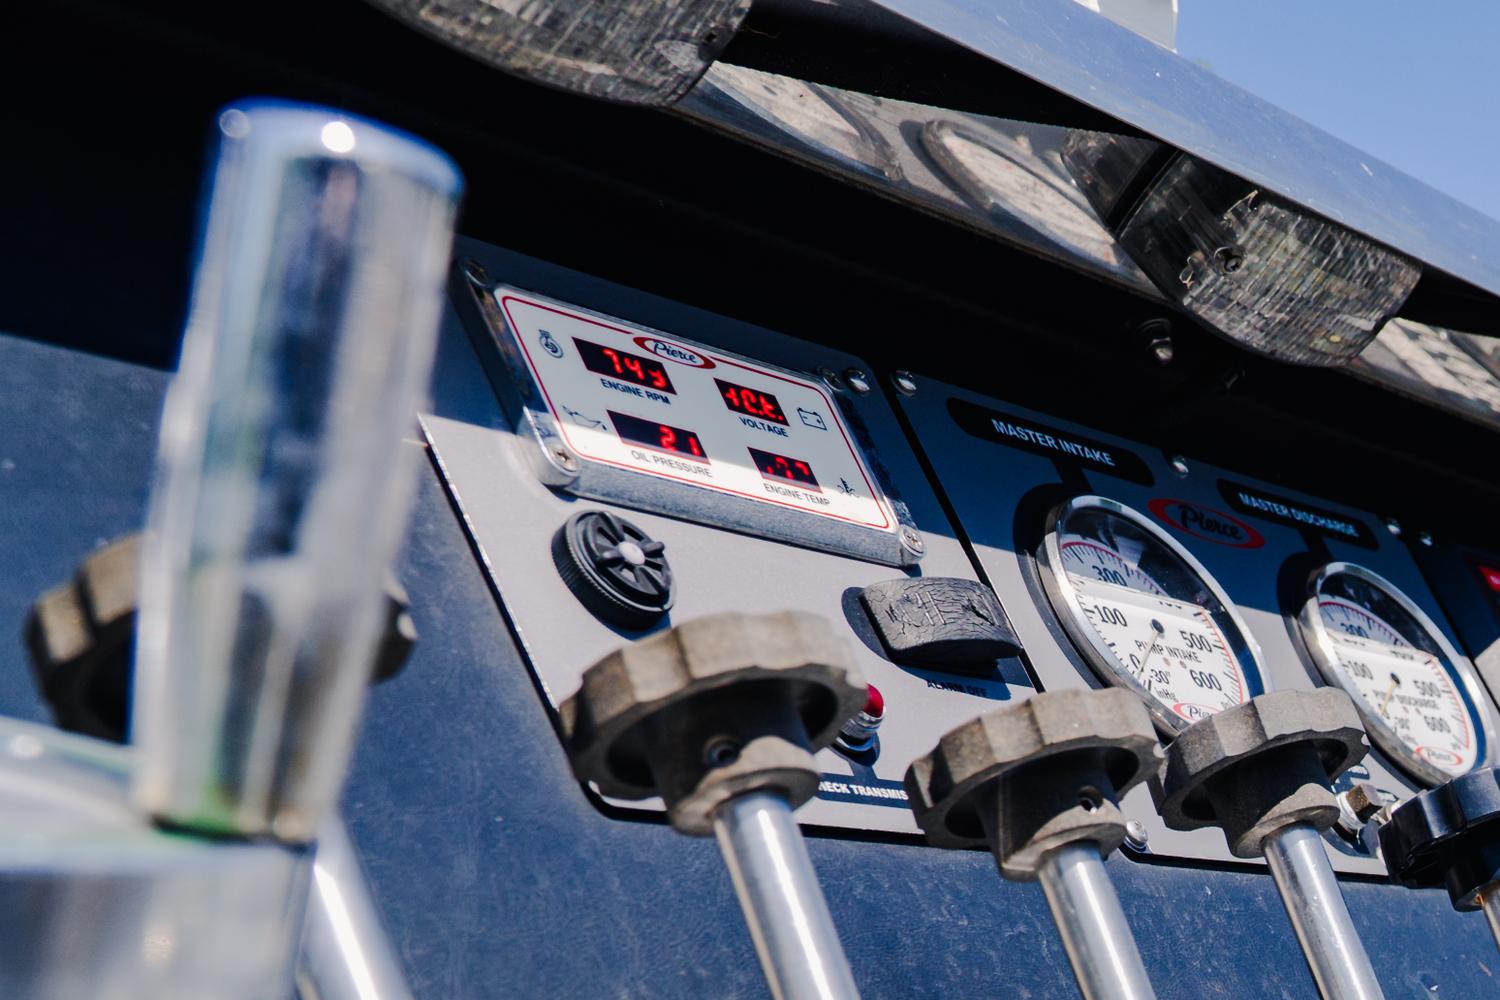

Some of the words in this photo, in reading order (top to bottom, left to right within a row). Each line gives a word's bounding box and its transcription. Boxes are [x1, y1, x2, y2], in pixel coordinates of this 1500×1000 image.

[653, 340, 698, 364] Pierce
[600, 378, 645, 398] ENGINE
[645, 390, 672, 405] RPM
[739, 416, 789, 438] VOLTAGE
[991, 418, 1057, 449] MASTER
[1058, 438, 1116, 467] INTAKE
[631, 449, 650, 463] OIL
[653, 455, 713, 478] PRESSURE
[763, 483, 803, 501] ENGINE
[803, 492, 830, 506] TEMP
[1177, 504, 1242, 541] Pierce
[1238, 491, 1291, 519] MASTER
[1292, 509, 1360, 538] DISCHARGE
[1091, 565, 1128, 588] 300
[1094, 604, 1128, 627] 100
[1179, 630, 1213, 653] 500
[1164, 645, 1202, 664] INTAKE
[1190, 669, 1222, 692] 600
[1413, 679, 1442, 699] 500
[1424, 715, 1451, 734] 600
[818, 781, 849, 795] HECK
[850, 784, 910, 801] TRANSMIS
